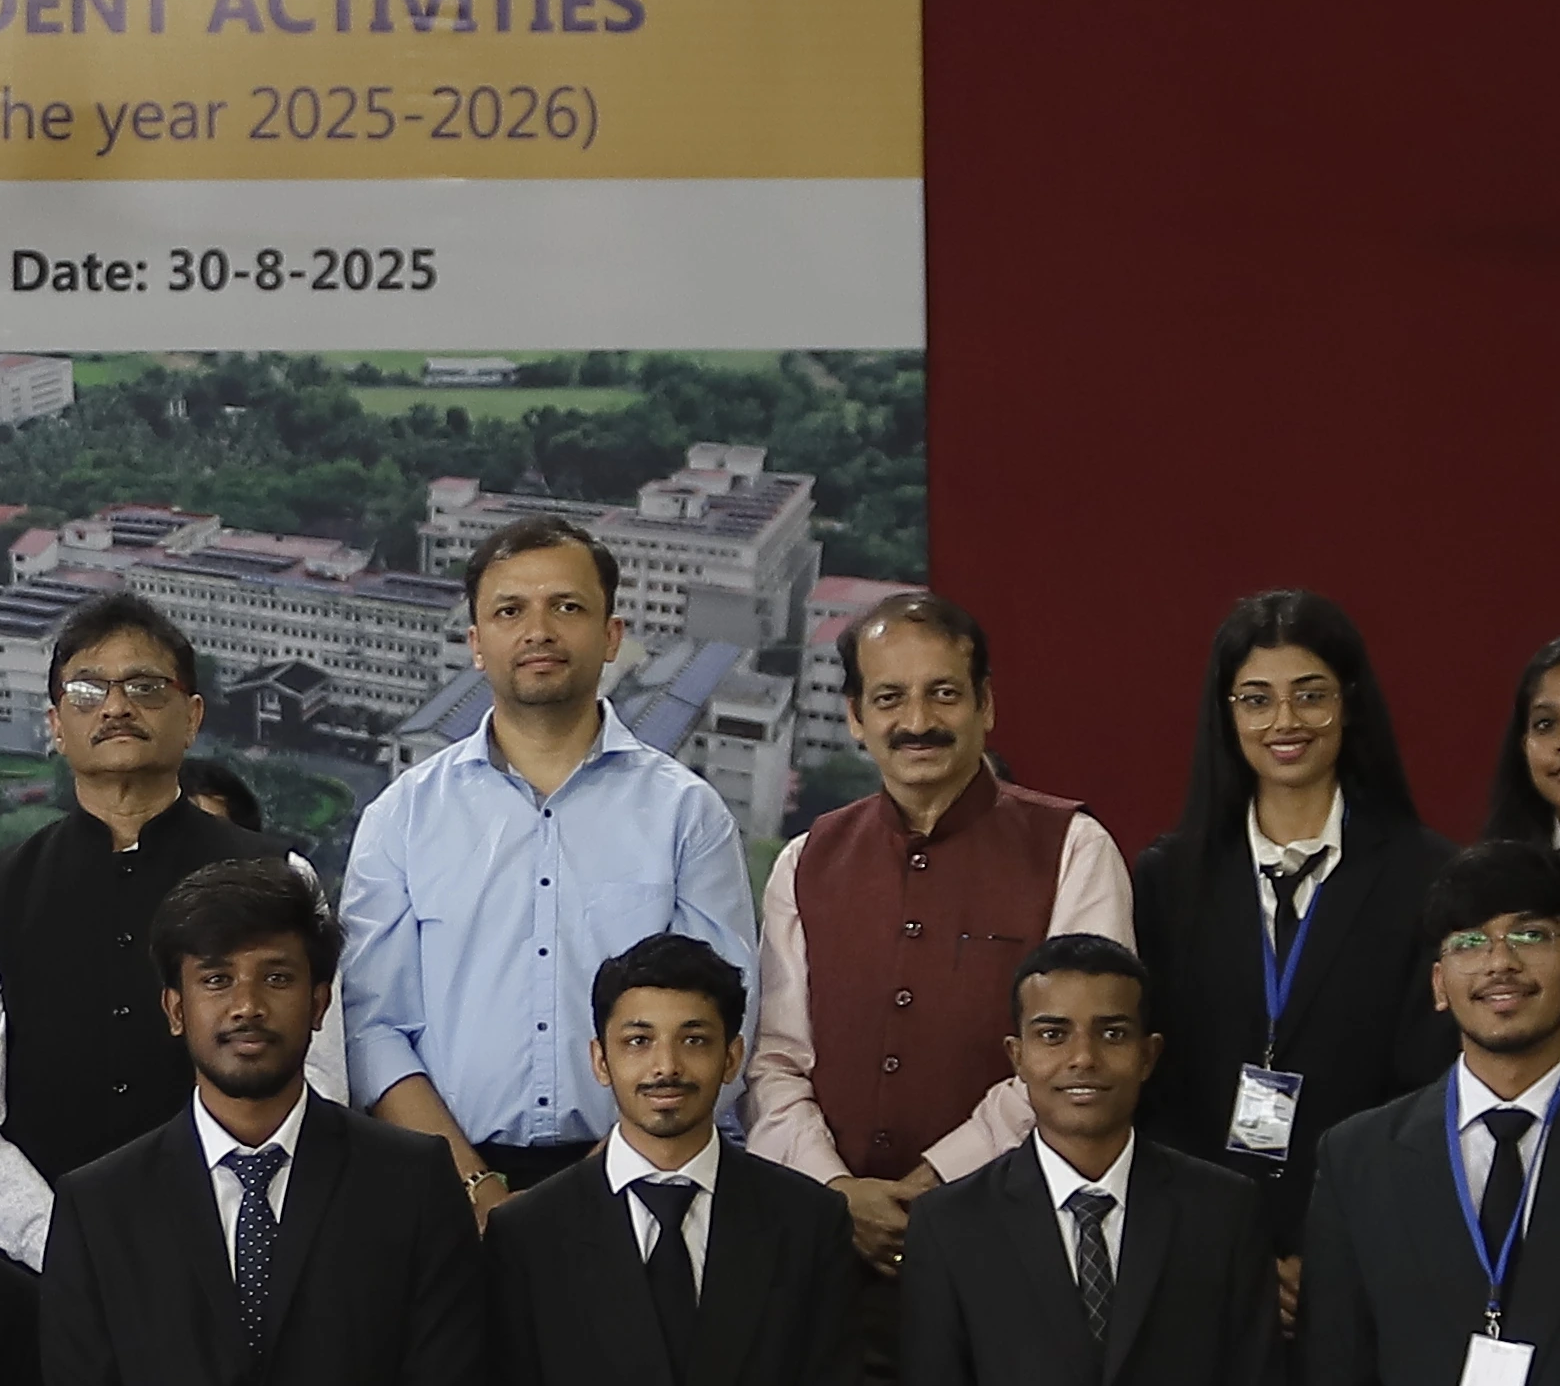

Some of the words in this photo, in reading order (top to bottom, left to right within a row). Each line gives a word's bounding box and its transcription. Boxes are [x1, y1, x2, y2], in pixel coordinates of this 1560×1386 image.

[95, 99, 229, 157] year
[248, 84, 600, 151] 2025-2026)
[11, 249, 149, 293] Date:
[168, 247, 439, 292] 30-8-2025
